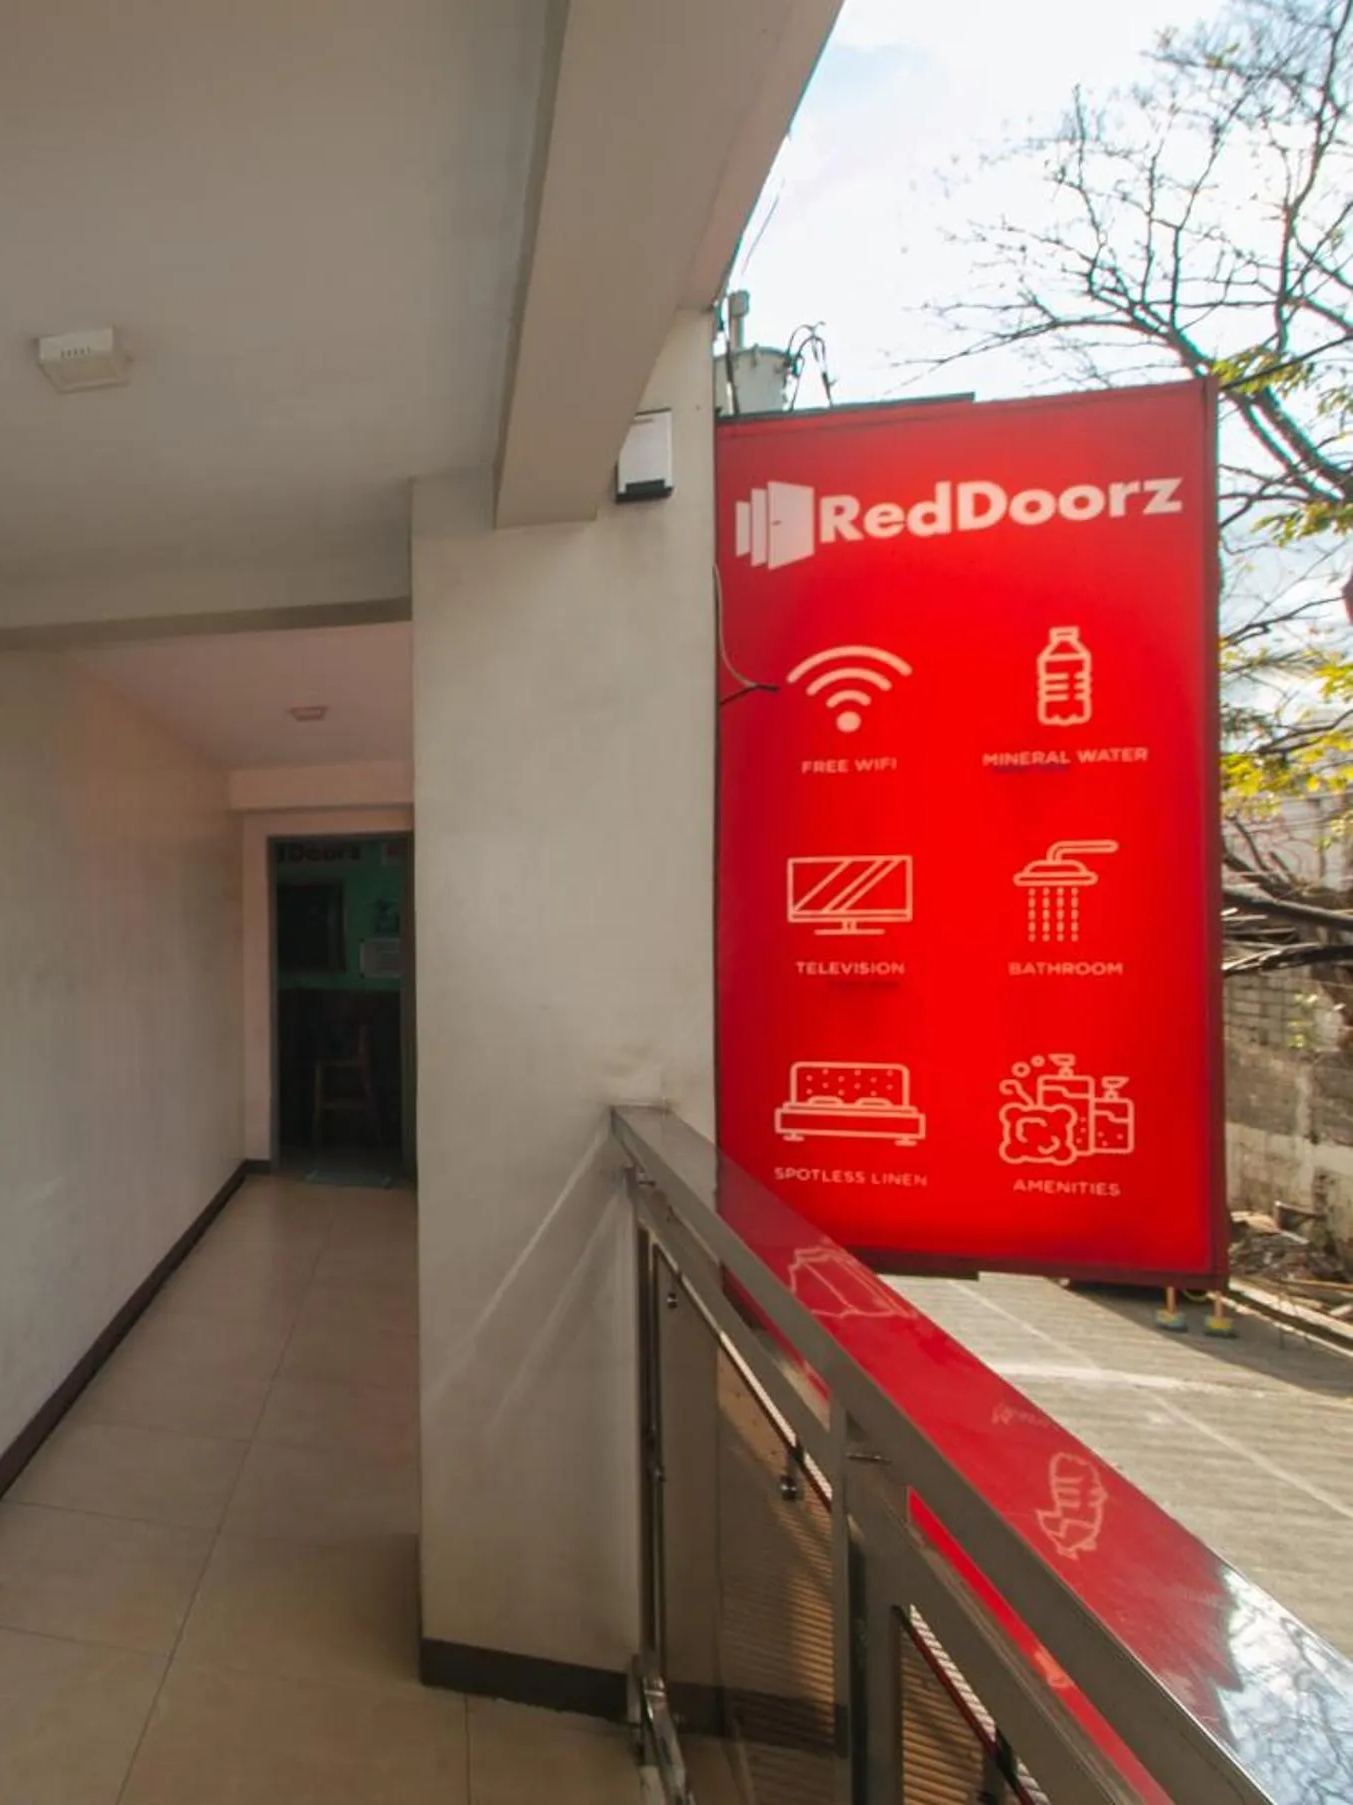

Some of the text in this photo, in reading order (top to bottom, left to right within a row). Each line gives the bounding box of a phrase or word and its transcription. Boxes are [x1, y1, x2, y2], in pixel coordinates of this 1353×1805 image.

[819, 476, 1184, 544] RedDoorz
[801, 756, 898, 774] FREE WIFI
[982, 746, 1149, 768] MINERAL WATER
[795, 961, 906, 976] TELEVISION
[1008, 961, 1124, 977] BATHROOM
[774, 1166, 929, 1189] SPOTLESS LINEN
[1012, 1178, 1122, 1198] AMENITIES
